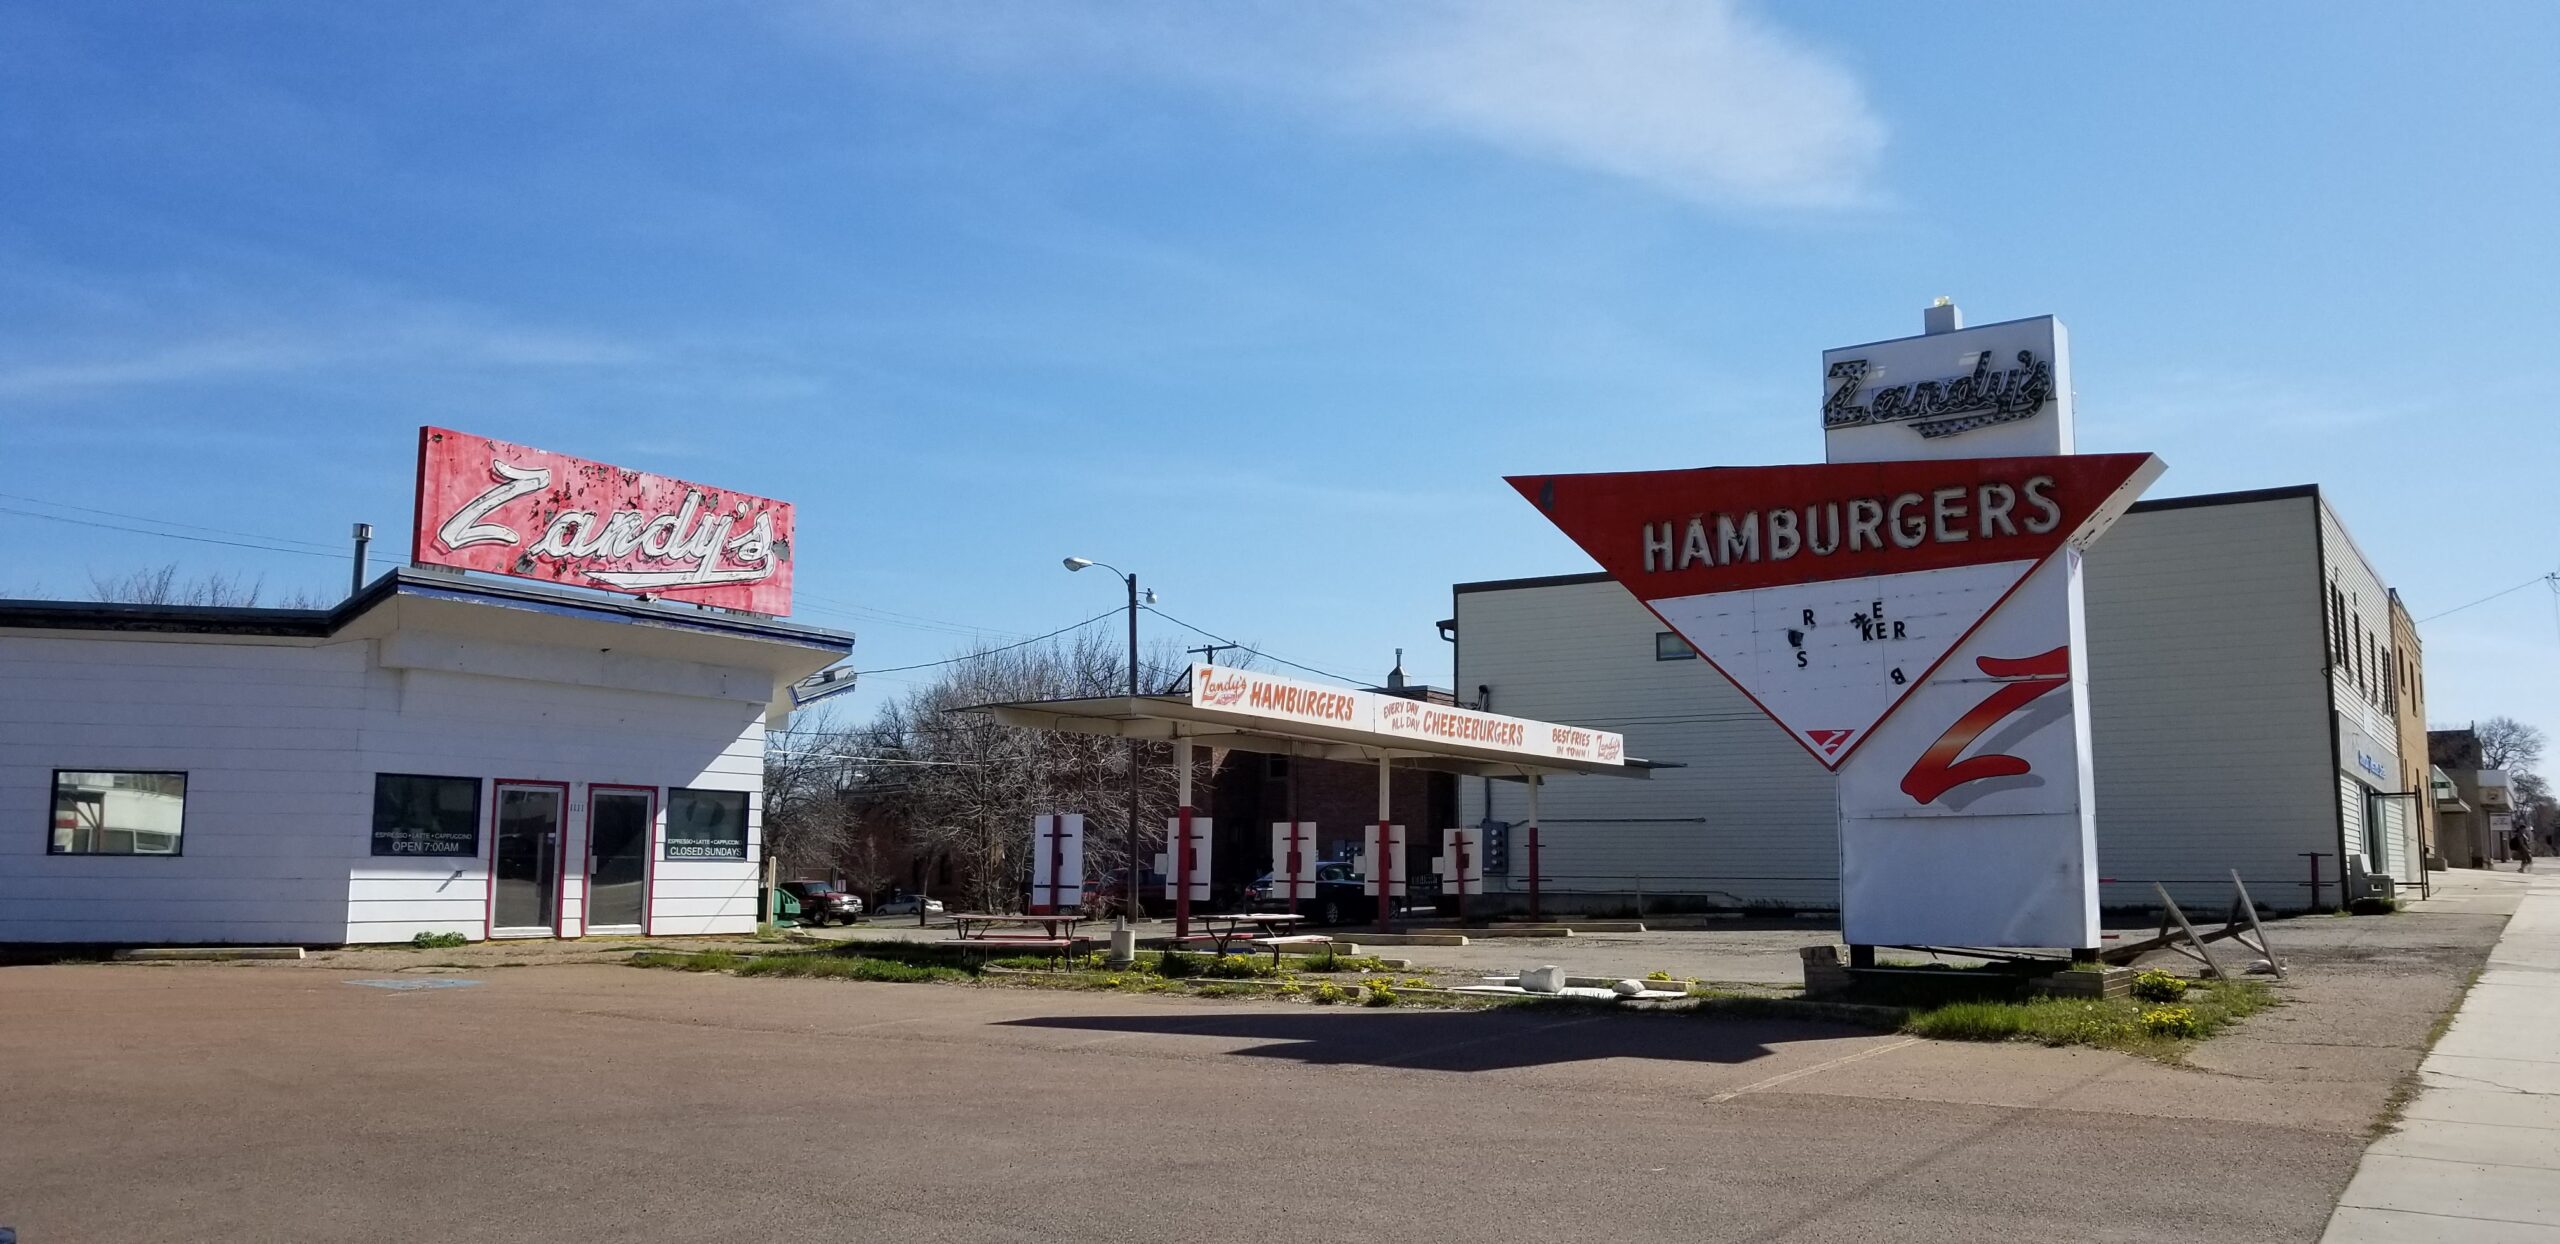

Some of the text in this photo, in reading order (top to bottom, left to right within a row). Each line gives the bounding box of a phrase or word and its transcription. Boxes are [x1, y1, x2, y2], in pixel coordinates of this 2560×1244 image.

[1820, 350, 2052, 440] Zandy's
[437, 459, 775, 590] Zandy's
[1643, 475, 2062, 574] HAMBURGERS
[1200, 668, 1354, 722] Zandy's HAMBURGERS
[1384, 701, 1420, 719] EVERY DAY
[1391, 716, 1420, 732] ALL DAY
[1423, 710, 1524, 747] CHEESEBURGERS
[1552, 728, 1591, 748] BEST FRIES
[1557, 745, 1564, 755] IN
[375, 831, 472, 841] ESPRESSO LATTE CAPPUCCINO
[392, 841, 459, 852] OPEN 7:00AM
[670, 846, 742, 857] CLOSED SUNDAYS
